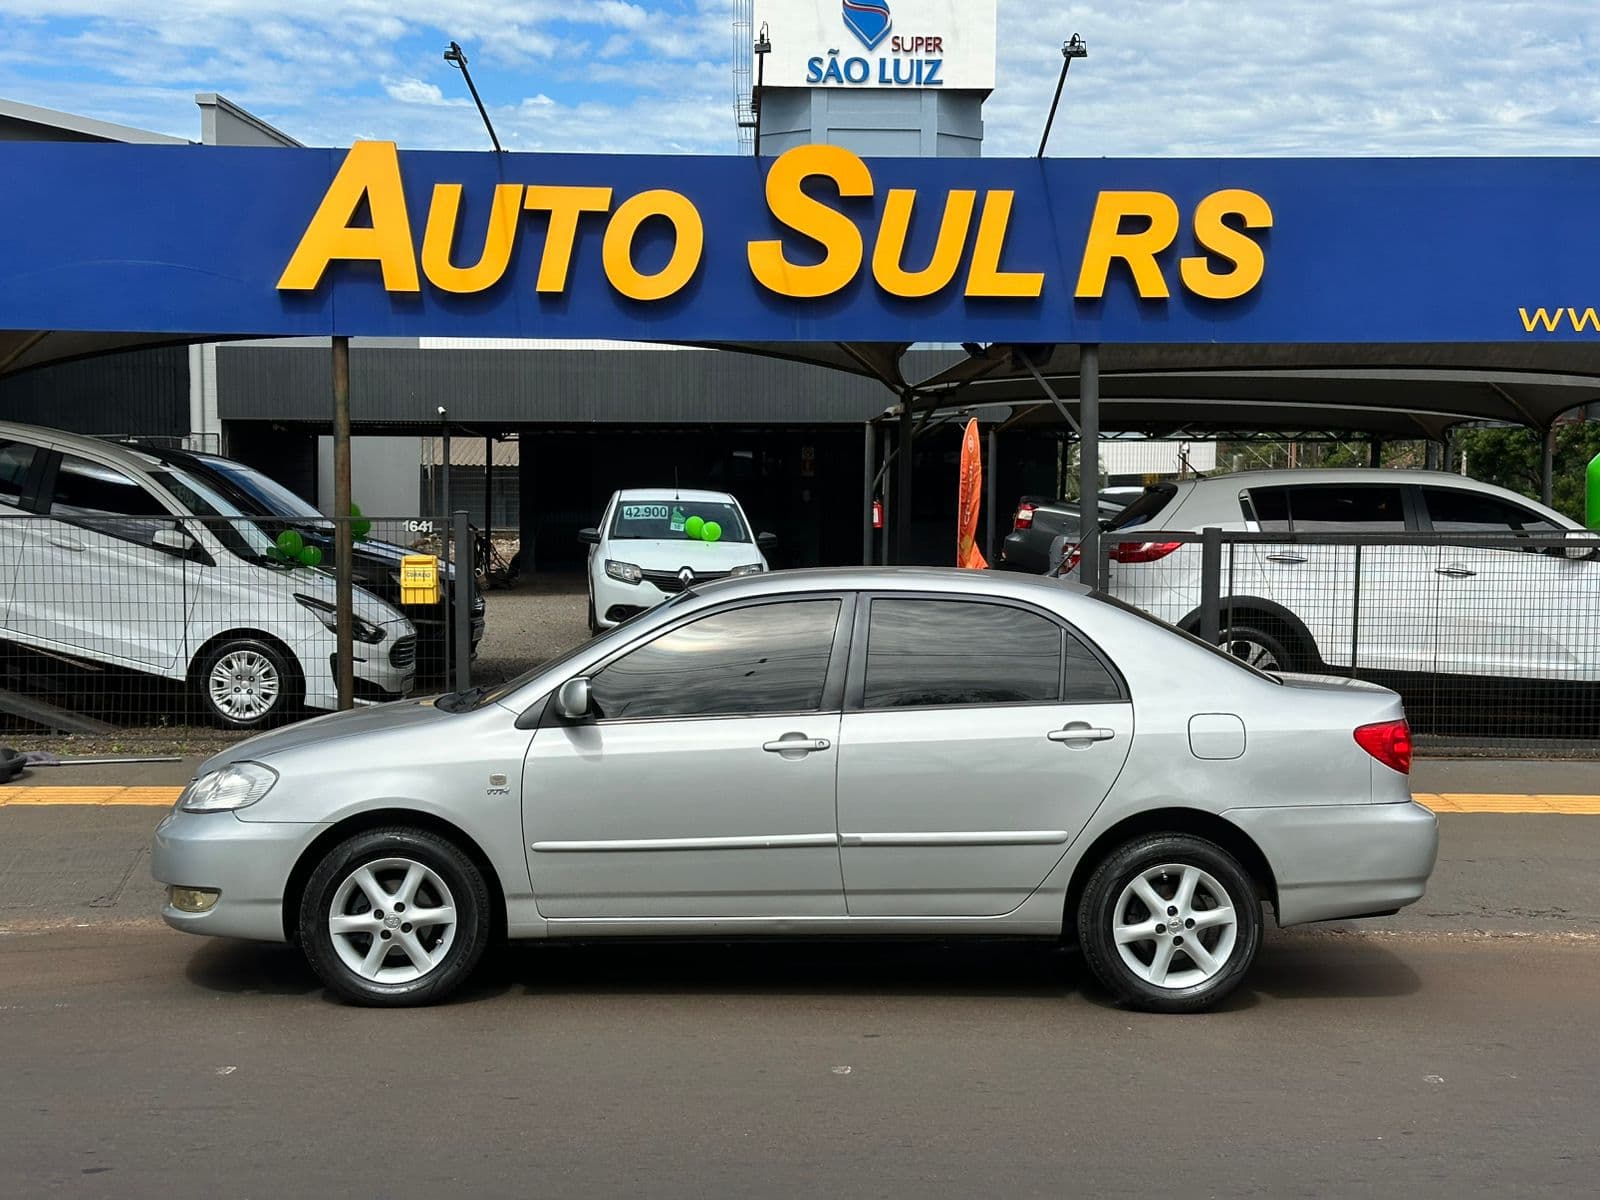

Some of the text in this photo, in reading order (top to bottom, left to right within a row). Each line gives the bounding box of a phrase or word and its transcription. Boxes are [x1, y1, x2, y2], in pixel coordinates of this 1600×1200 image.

[891, 35, 944, 53] SUPER
[806, 48, 944, 85] SÃO LUIZ
[276, 140, 1274, 301] AUTO SUL RS
[625, 506, 667, 518] 42.900
[402, 520, 433, 532] 1641
